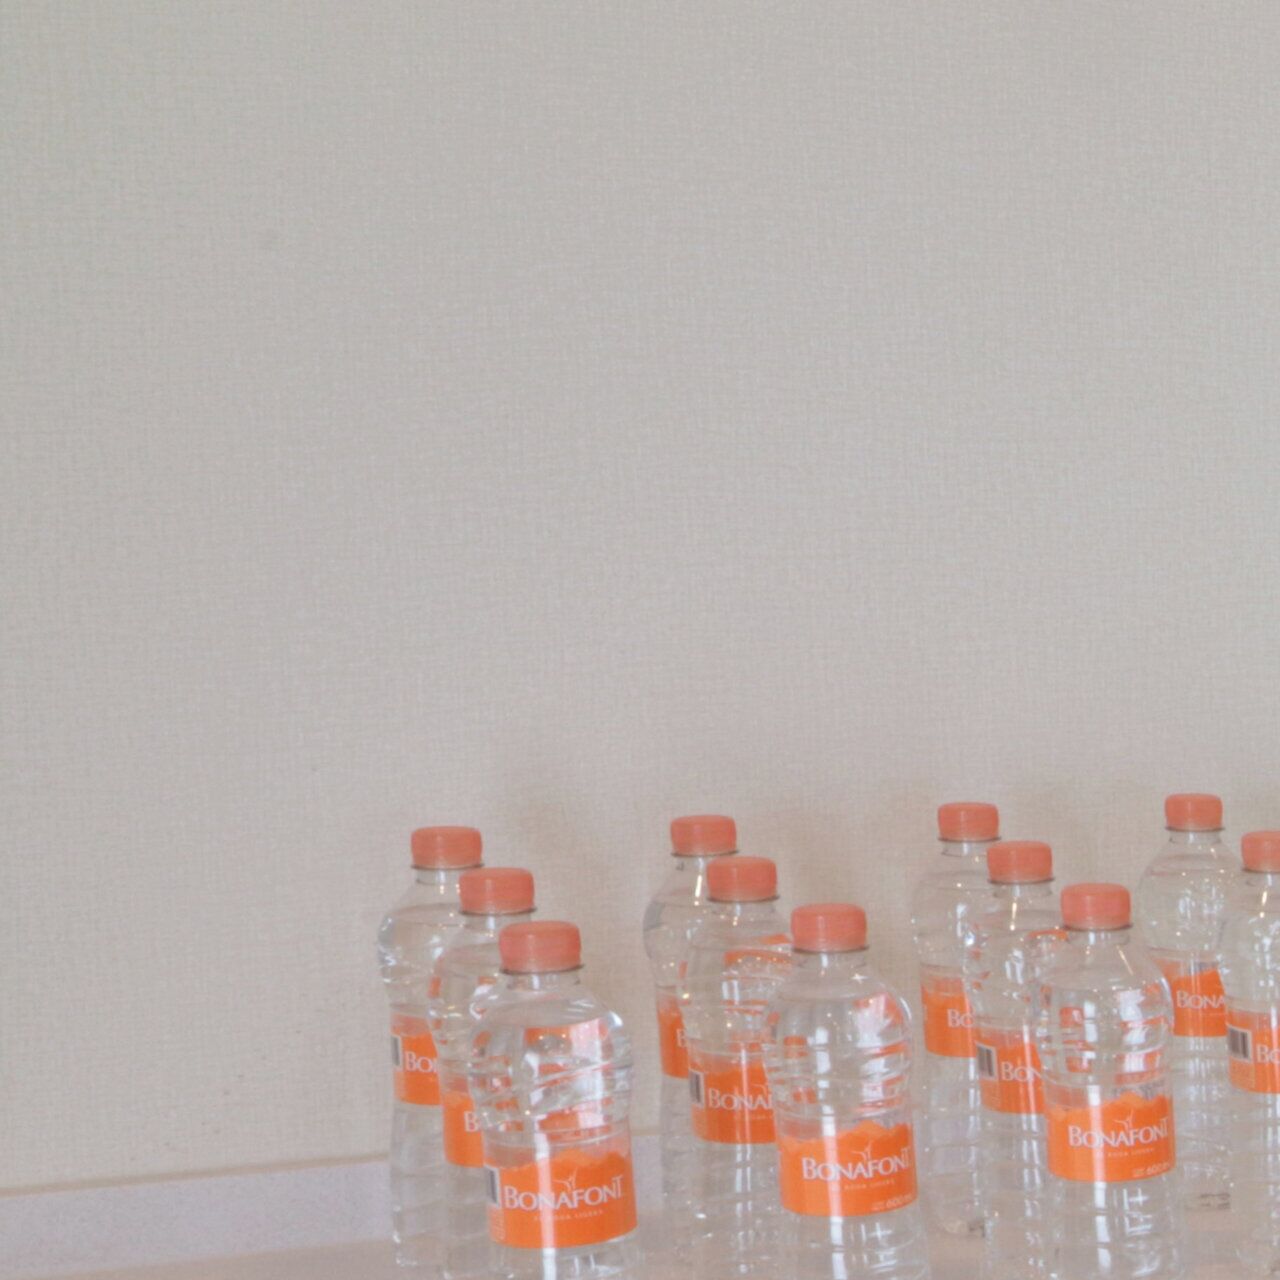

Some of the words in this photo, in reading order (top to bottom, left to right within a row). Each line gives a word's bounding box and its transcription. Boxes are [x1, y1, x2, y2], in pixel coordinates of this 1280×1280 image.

[1068, 1117, 1169, 1148] BONAFONT
[802, 1147, 910, 1181] BONAFONT
[504, 1174, 623, 1211] BONAFONT
